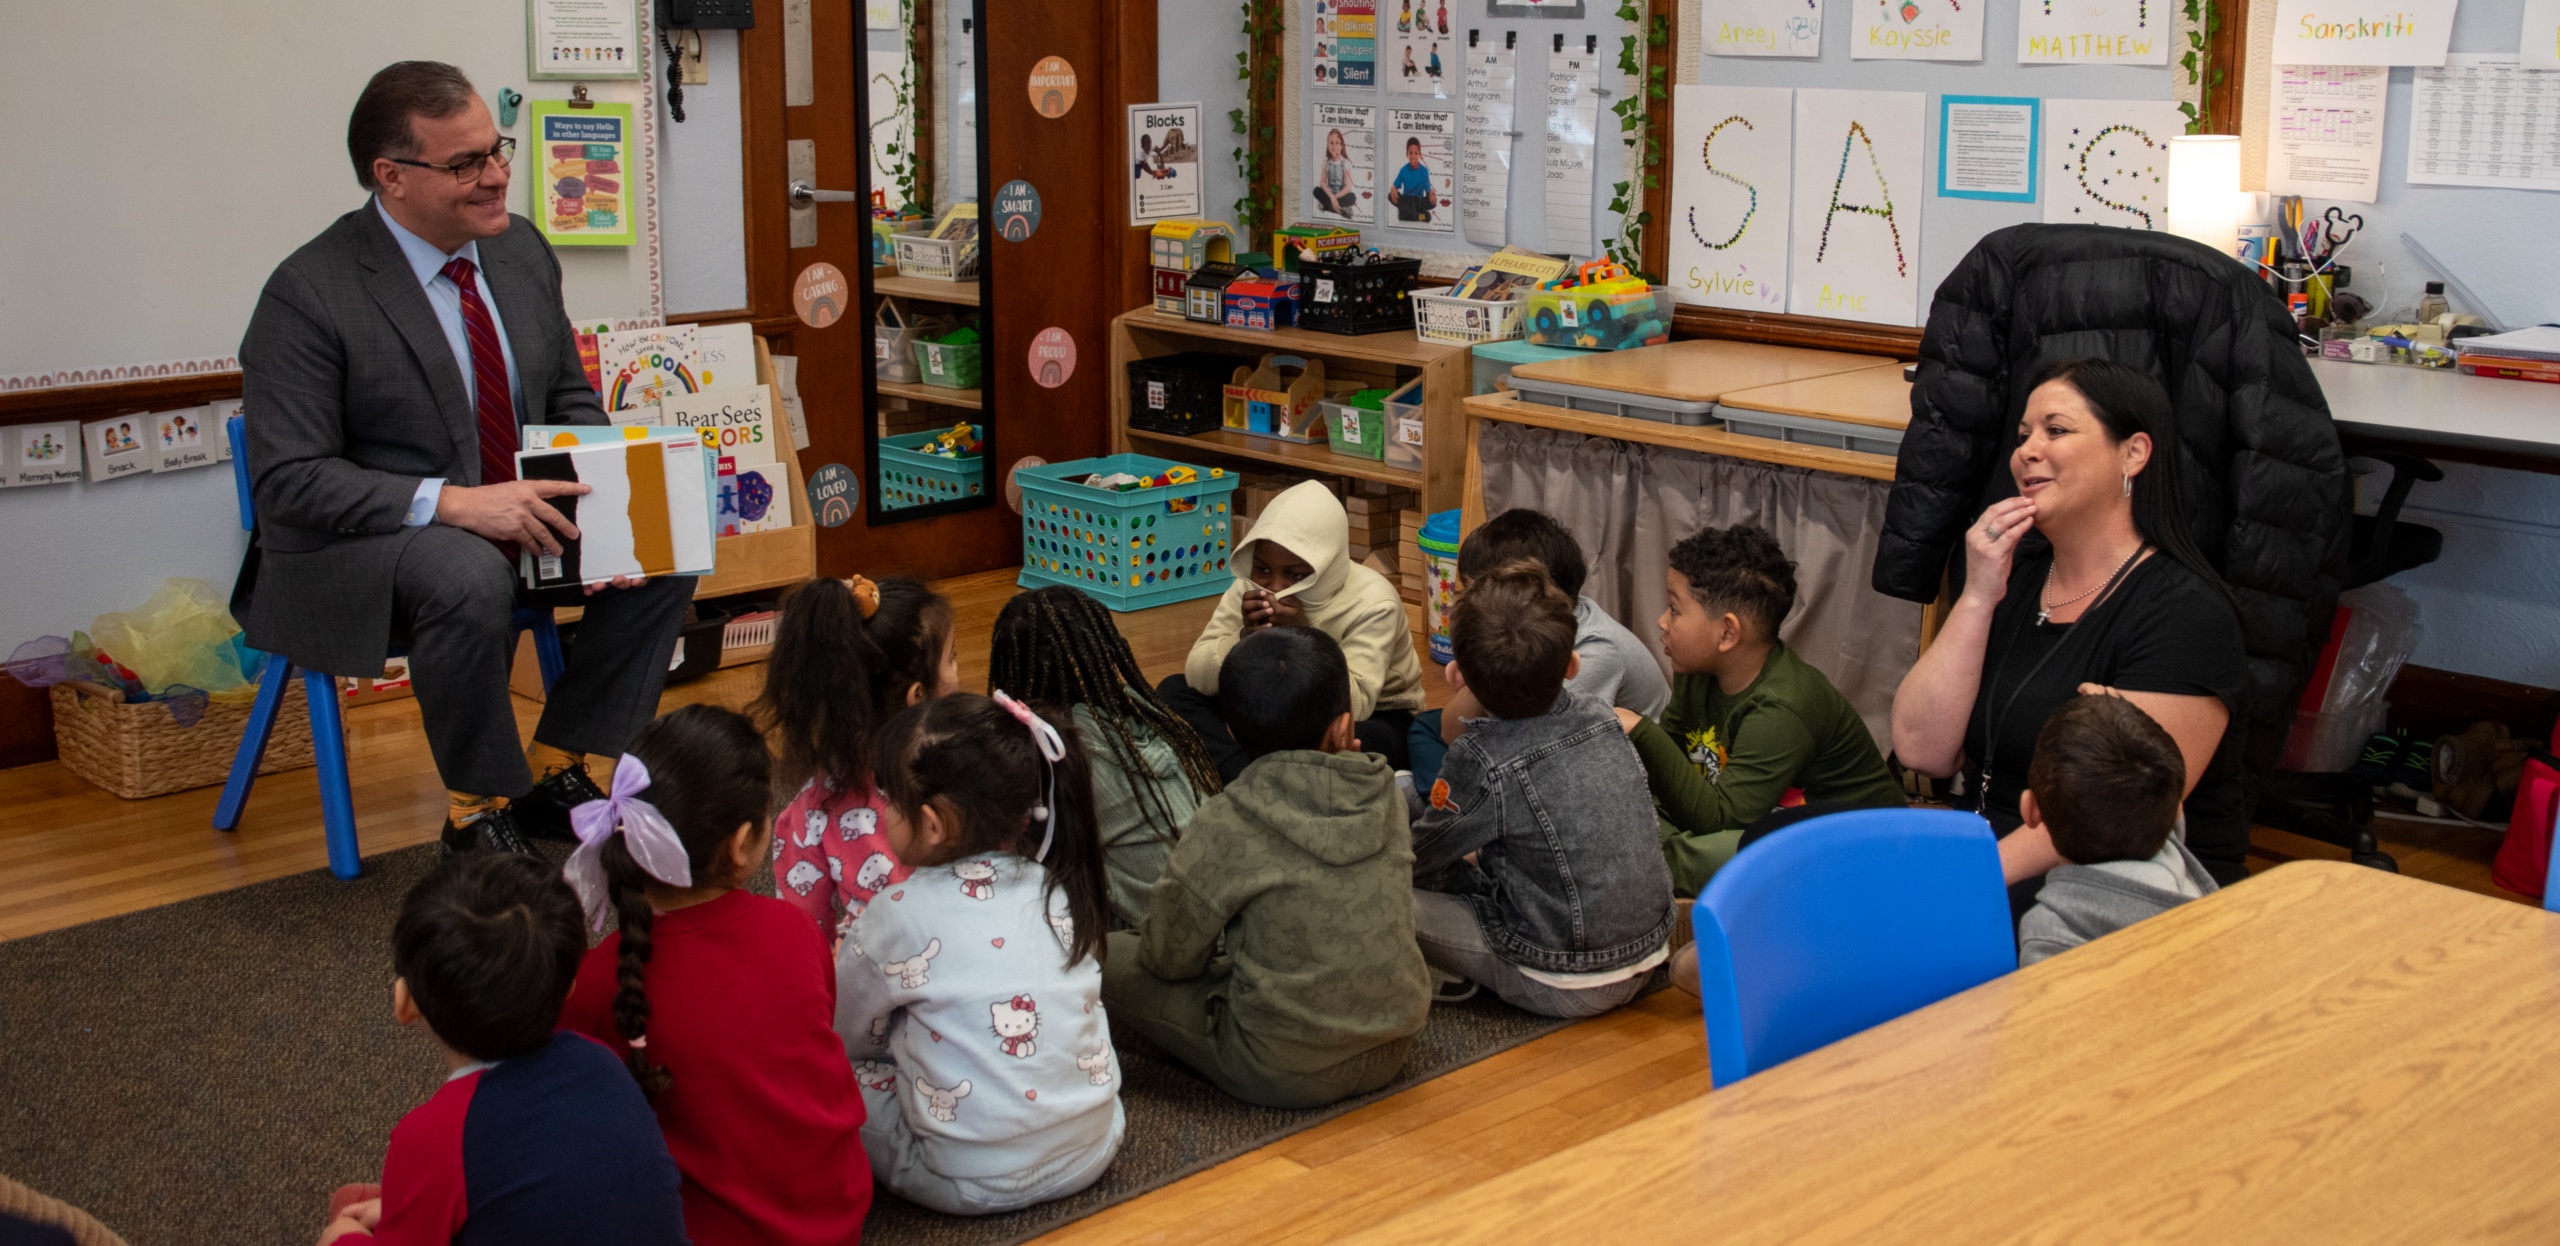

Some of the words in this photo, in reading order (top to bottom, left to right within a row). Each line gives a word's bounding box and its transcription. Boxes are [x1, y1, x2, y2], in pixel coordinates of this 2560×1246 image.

[1338, 0, 1375, 10] Shouting
[1339, 20, 1373, 35] Talking
[2298, 12, 2414, 41] Sanskriti
[1718, 22, 1775, 50] Areej
[1869, 23, 1951, 52] Kayssie
[1339, 45, 1374, 60] Whisper
[2029, 34, 2153, 60] MATTHEW
[1485, 56, 1497, 64] AM
[1568, 61, 1580, 69] PM
[1049, 61, 1060, 72] AM
[1467, 67, 1487, 76] Sylvie
[1343, 67, 1370, 80] Silent
[1030, 75, 1075, 87] IMPORTANT
[1467, 80, 1489, 88] Arthur
[1549, 85, 1573, 93] Grace
[1467, 92, 1500, 101] Meghann
[1337, 106, 1353, 115] show
[1355, 107, 1369, 116] that
[1466, 103, 1480, 111] Aric
[1146, 114, 1185, 129] Blocks
[1400, 112, 1412, 120] can
[1414, 112, 1432, 120] show
[1433, 113, 1448, 121] that
[554, 122, 573, 130] Ways
[581, 131, 616, 140] languages
[1464, 139, 1482, 149] Areej
[1464, 150, 1486, 160] Sophie
[1463, 162, 1487, 172] Kayssie
[1463, 174, 1477, 182] Elias
[1014, 184, 1026, 197] AM
[1462, 186, 1484, 194] Daniel
[1815, 119, 1909, 278] A
[1001, 199, 1033, 213] SMART
[1463, 209, 1478, 219] Elijah
[1487, 257, 1537, 273] ALPHABET
[1535, 264, 1560, 276] CITY
[812, 266, 825, 281] AM
[1687, 266, 1754, 296] Sylvie
[803, 279, 839, 301] CARING
[1817, 284, 1867, 312] Aric
[1427, 306, 1465, 328] Books
[650, 333, 685, 351] CRAYONS
[1051, 332, 1062, 343] AM
[701, 349, 726, 364] ESS
[1038, 346, 1067, 358] PROUD
[1225, 388, 1245, 397] PARK
[675, 411, 719, 427] Bear
[722, 405, 762, 426] Sees
[721, 424, 763, 447] ORS
[164, 457, 182, 468] Body
[183, 453, 207, 464] Break
[108, 462, 136, 474] Snack
[718, 463, 733, 471] RIS
[20, 472, 53, 484] Morning
[825, 466, 837, 481] AM
[816, 479, 847, 500] LOVED
